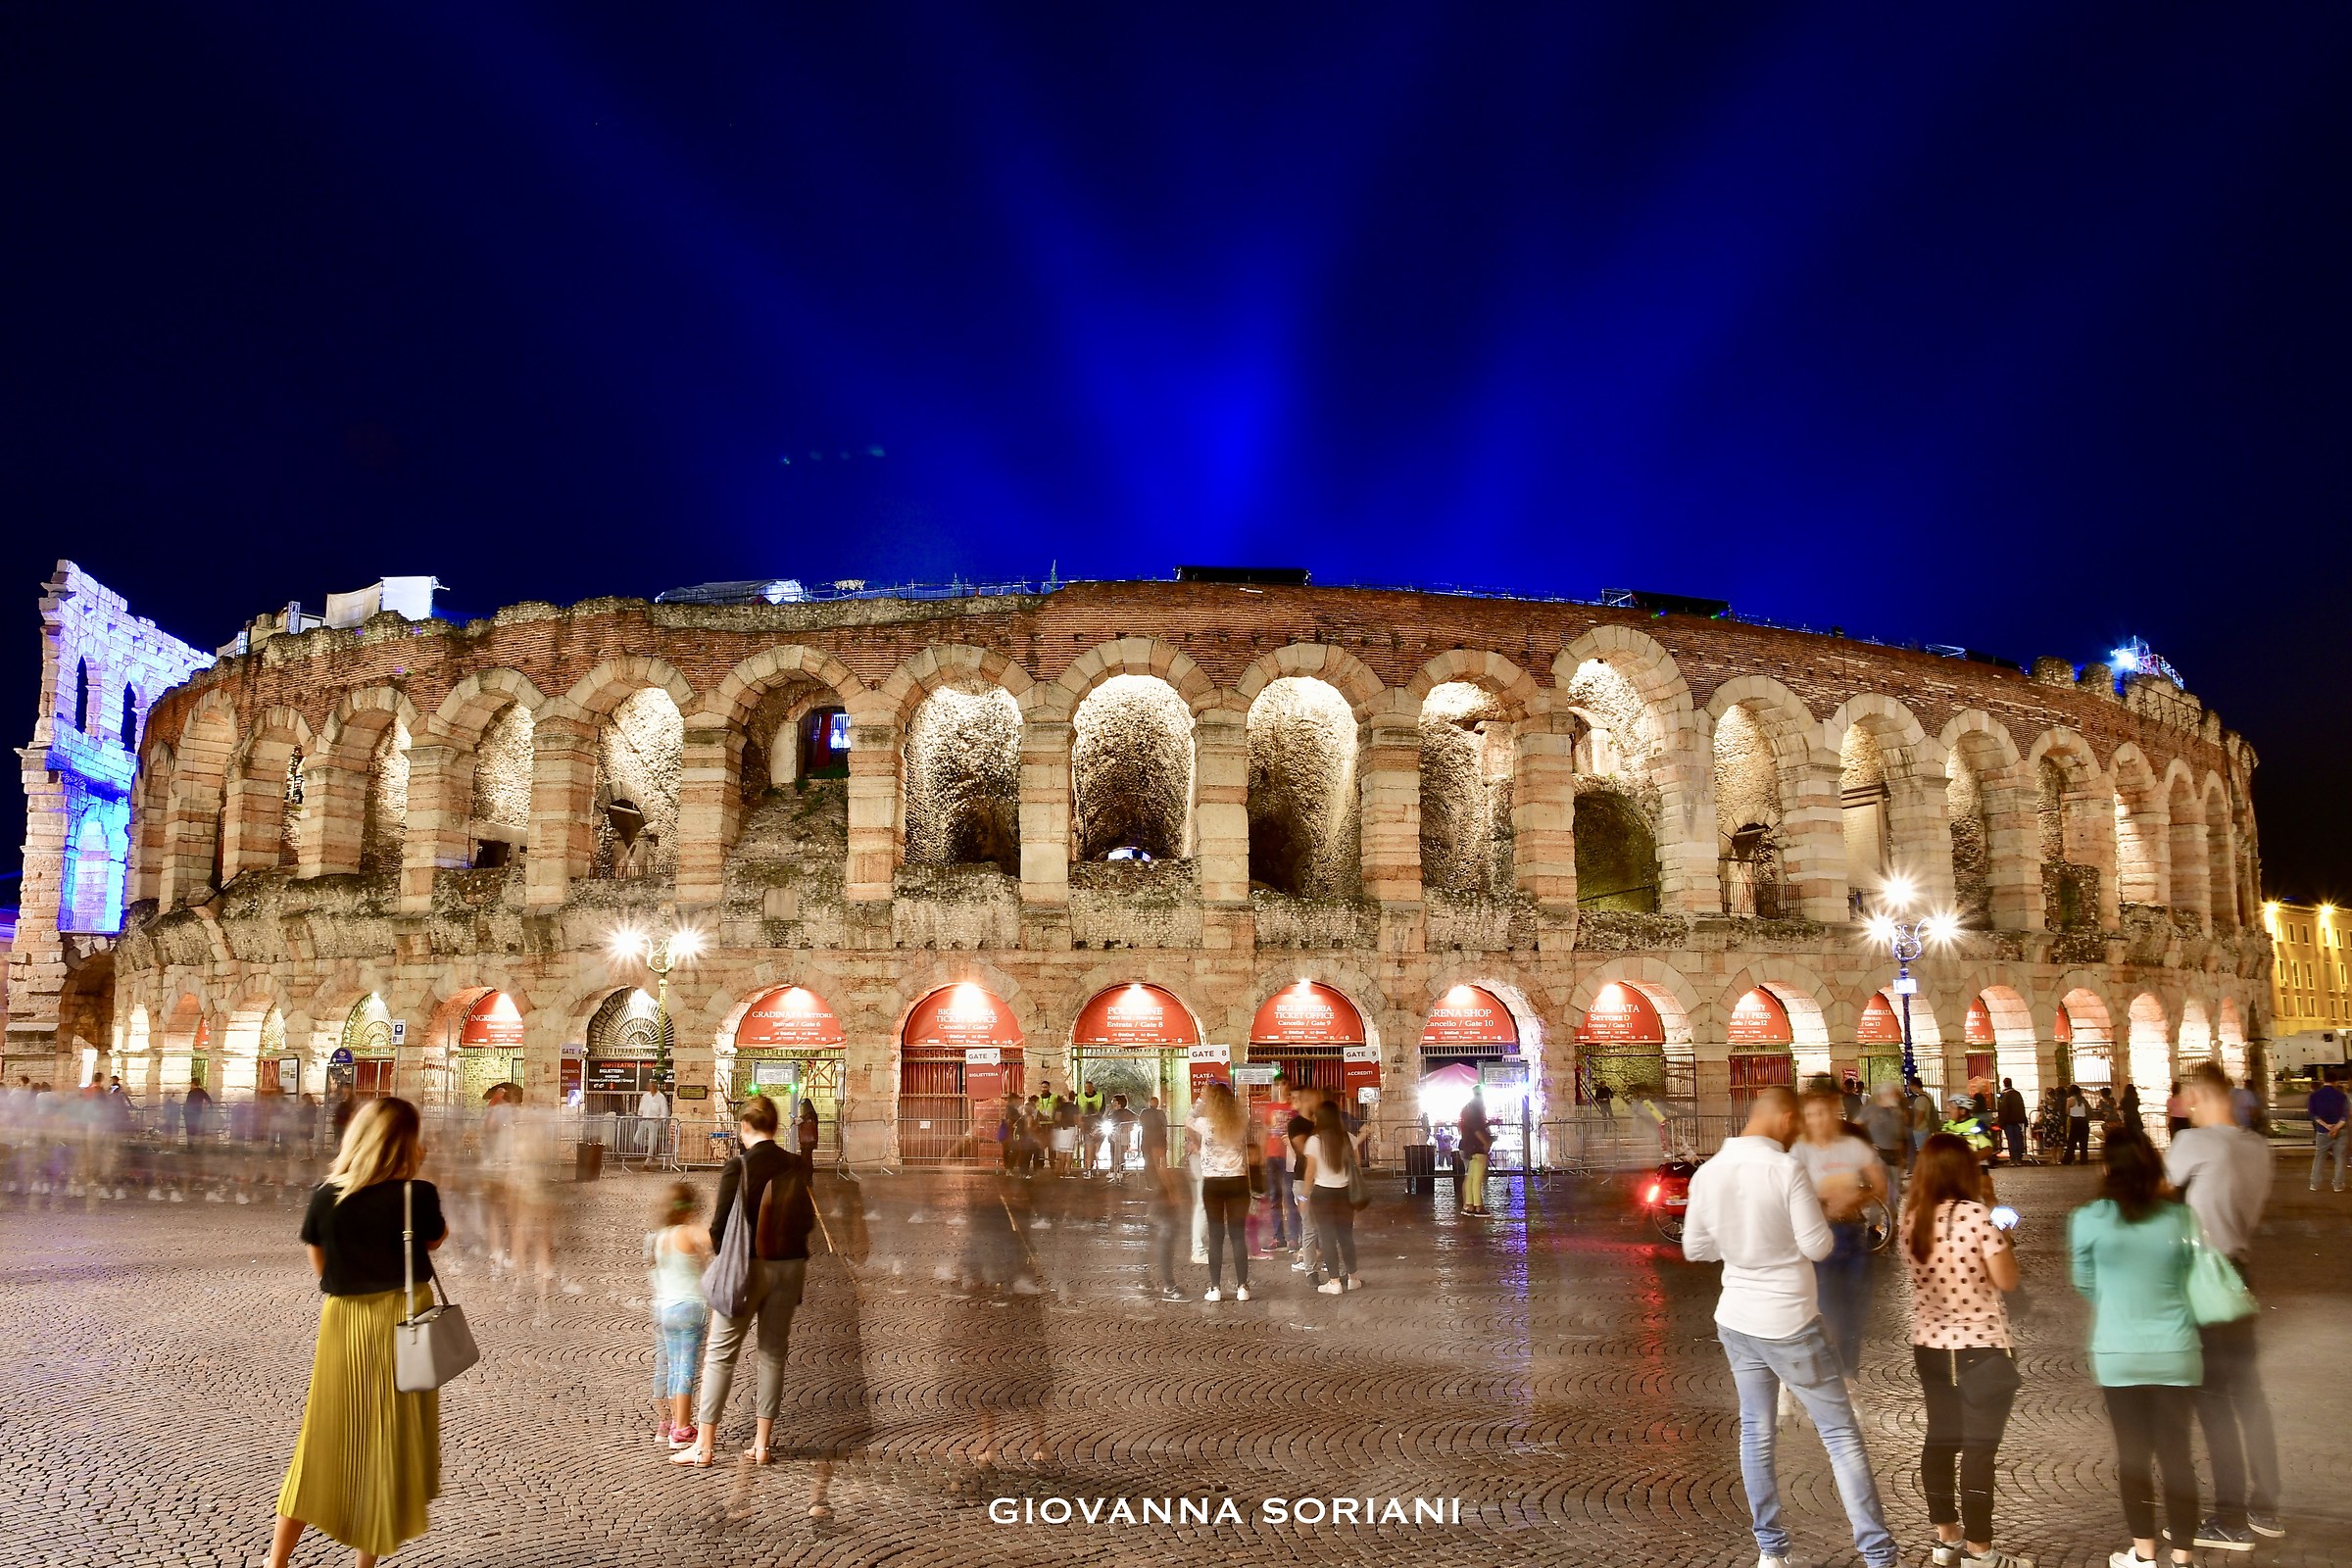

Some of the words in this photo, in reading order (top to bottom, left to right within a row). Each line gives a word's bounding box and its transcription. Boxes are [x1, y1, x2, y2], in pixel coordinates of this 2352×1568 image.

[1106, 1006, 1163, 1015] POLTNE
[1430, 1008, 1462, 1017] RENA
[1463, 1008, 1493, 1017] SHOP
[1588, 1004, 1641, 1013] RADINATA
